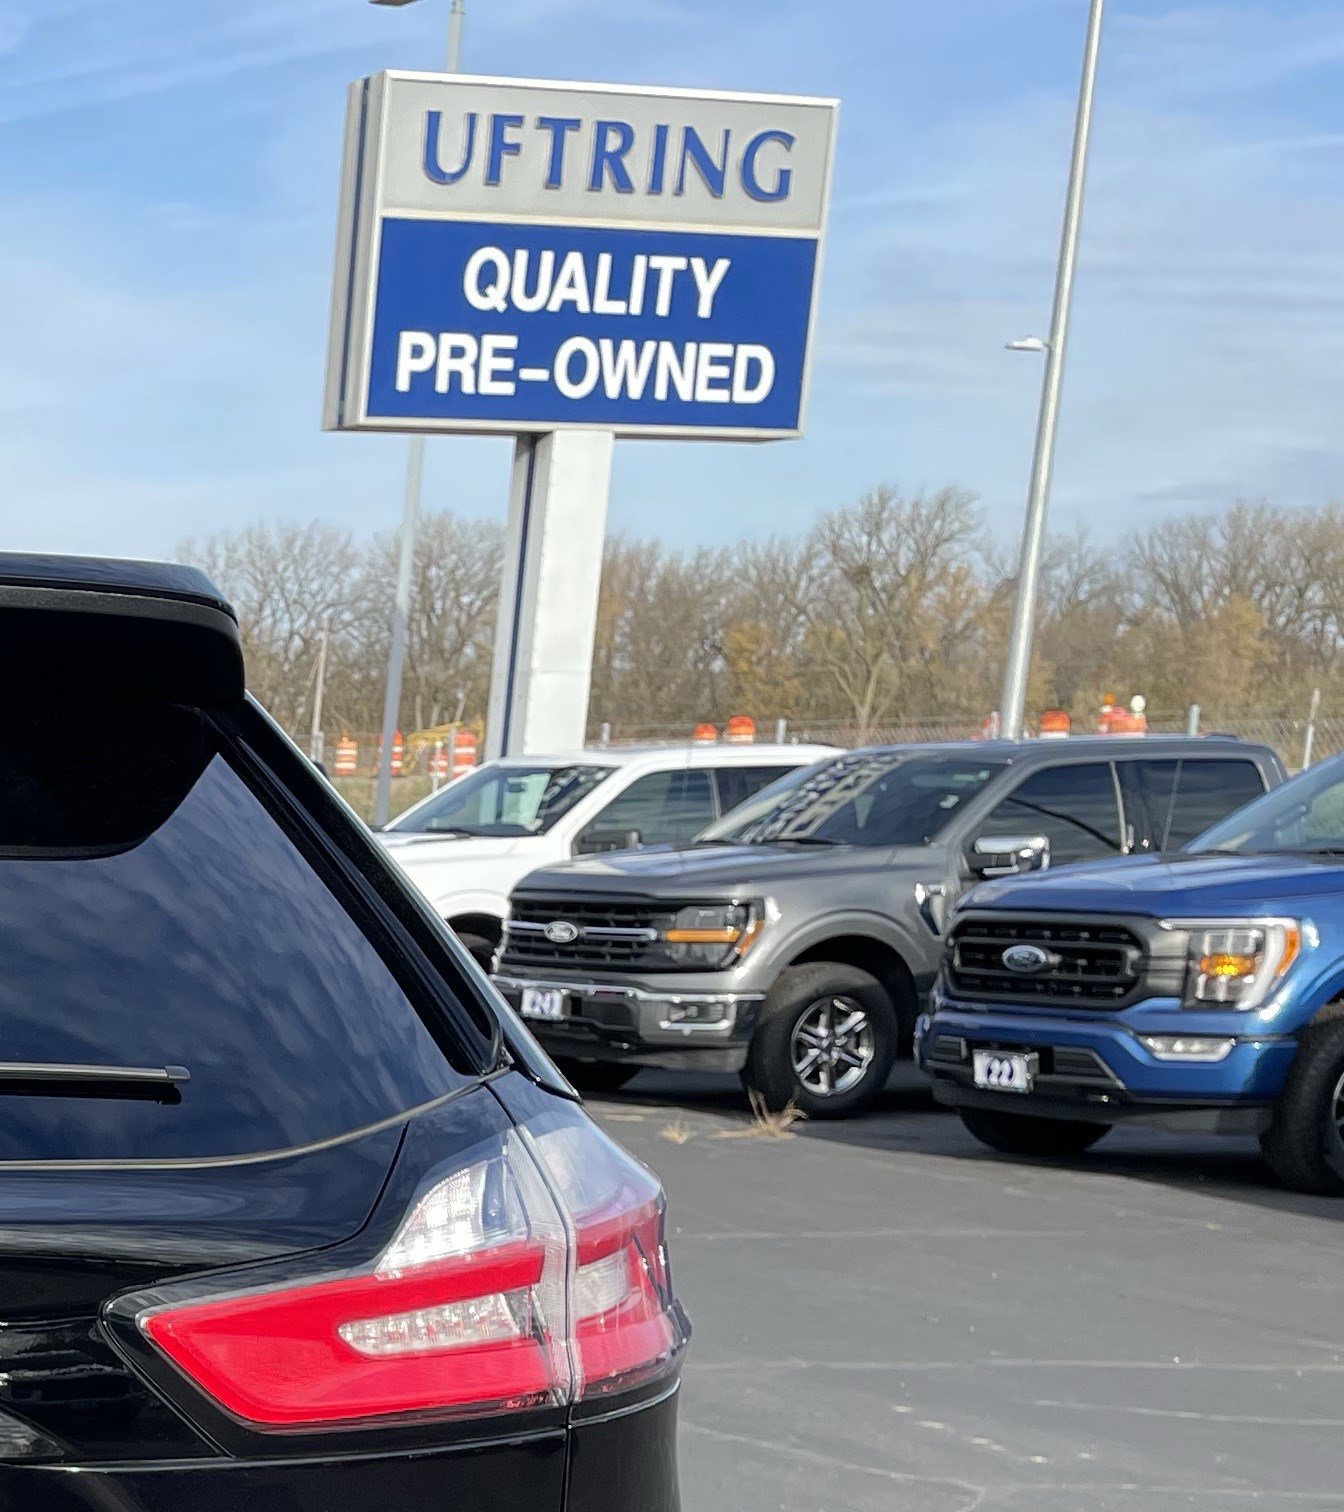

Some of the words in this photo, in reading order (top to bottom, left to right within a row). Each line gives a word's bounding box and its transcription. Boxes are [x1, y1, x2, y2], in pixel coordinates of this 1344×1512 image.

[422, 109, 796, 203] UFTRING
[463, 246, 732, 318] QUALITY
[395, 331, 776, 404] PRE-OWNED
